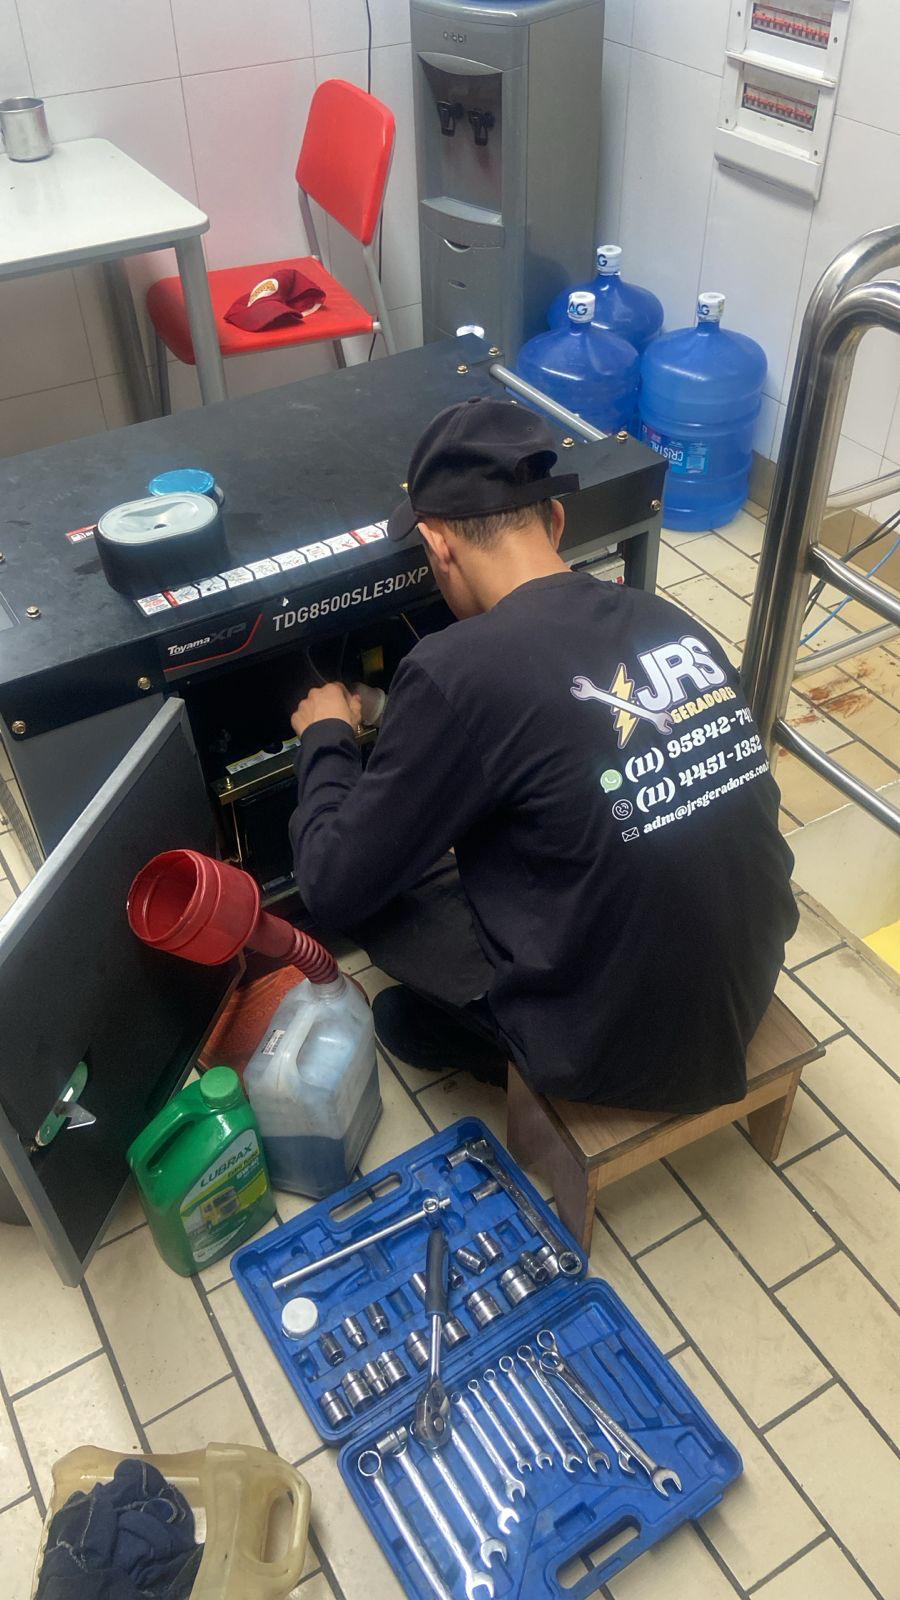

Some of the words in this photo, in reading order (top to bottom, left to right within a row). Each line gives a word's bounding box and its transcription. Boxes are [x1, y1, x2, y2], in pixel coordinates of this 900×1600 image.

[272, 566, 429, 632] TDG8500SLE3DXP
[168, 635, 211, 656] Toyama
[210, 622, 247, 641] XP
[636, 635, 727, 712] JRS
[625, 747, 665, 782] (11)
[636, 777, 676, 812] (11)
[679, 734, 762, 788] 4451-1352
[200, 1142, 253, 1188] LUBRAX
